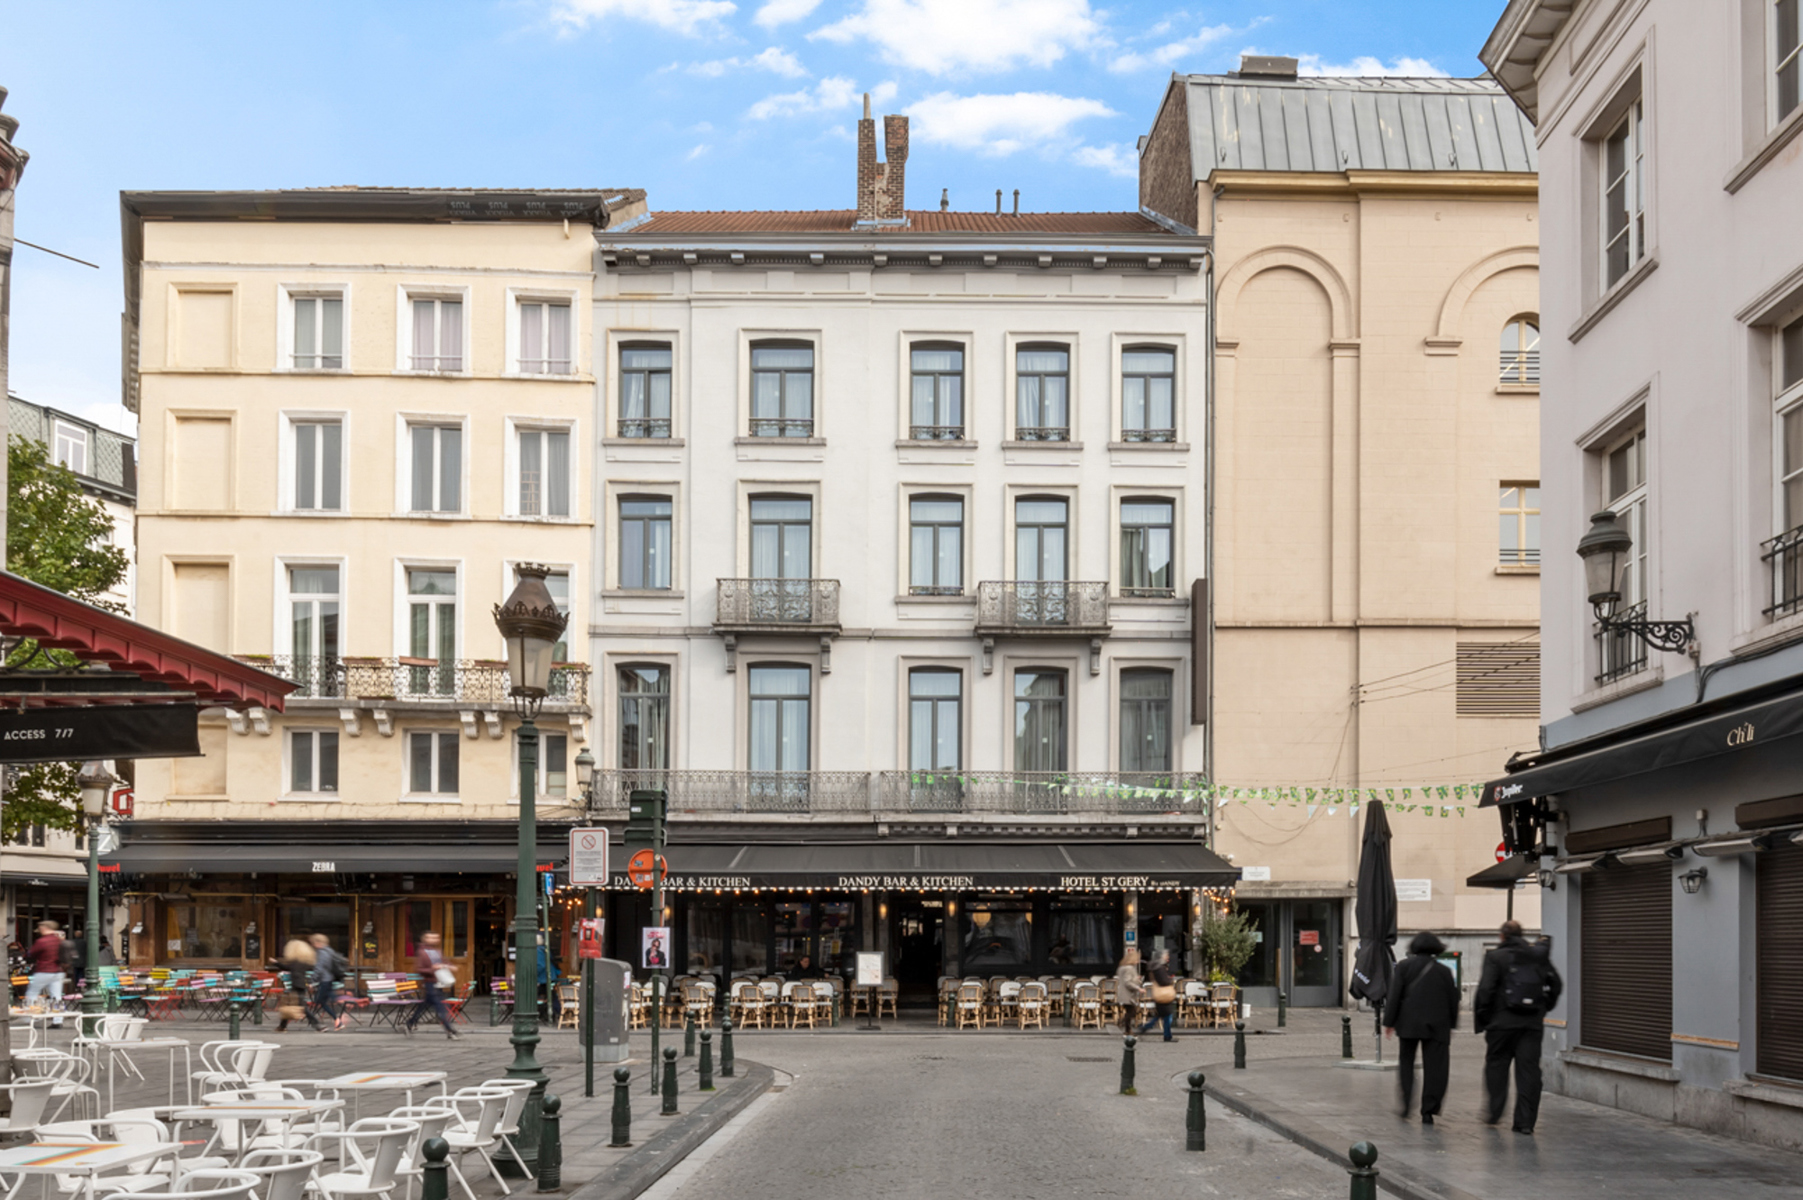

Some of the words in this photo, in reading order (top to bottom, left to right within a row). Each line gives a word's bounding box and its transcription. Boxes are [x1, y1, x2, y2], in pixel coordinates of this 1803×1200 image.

[4, 729, 46, 740] ACCESS
[55, 728, 74, 739] 7/7
[312, 861, 336, 872] ZEBRA
[660, 877, 684, 887] BAR
[686, 877, 697, 887] &
[698, 877, 751, 887] KITCHEN
[839, 876, 881, 887] DANDY
[883, 876, 907, 887] BAR
[909, 876, 920, 887] &
[922, 876, 974, 887] KITCHEN
[1061, 876, 1099, 887] HOTEL
[1101, 876, 1116, 887] ST
[1117, 876, 1150, 887] GERY
